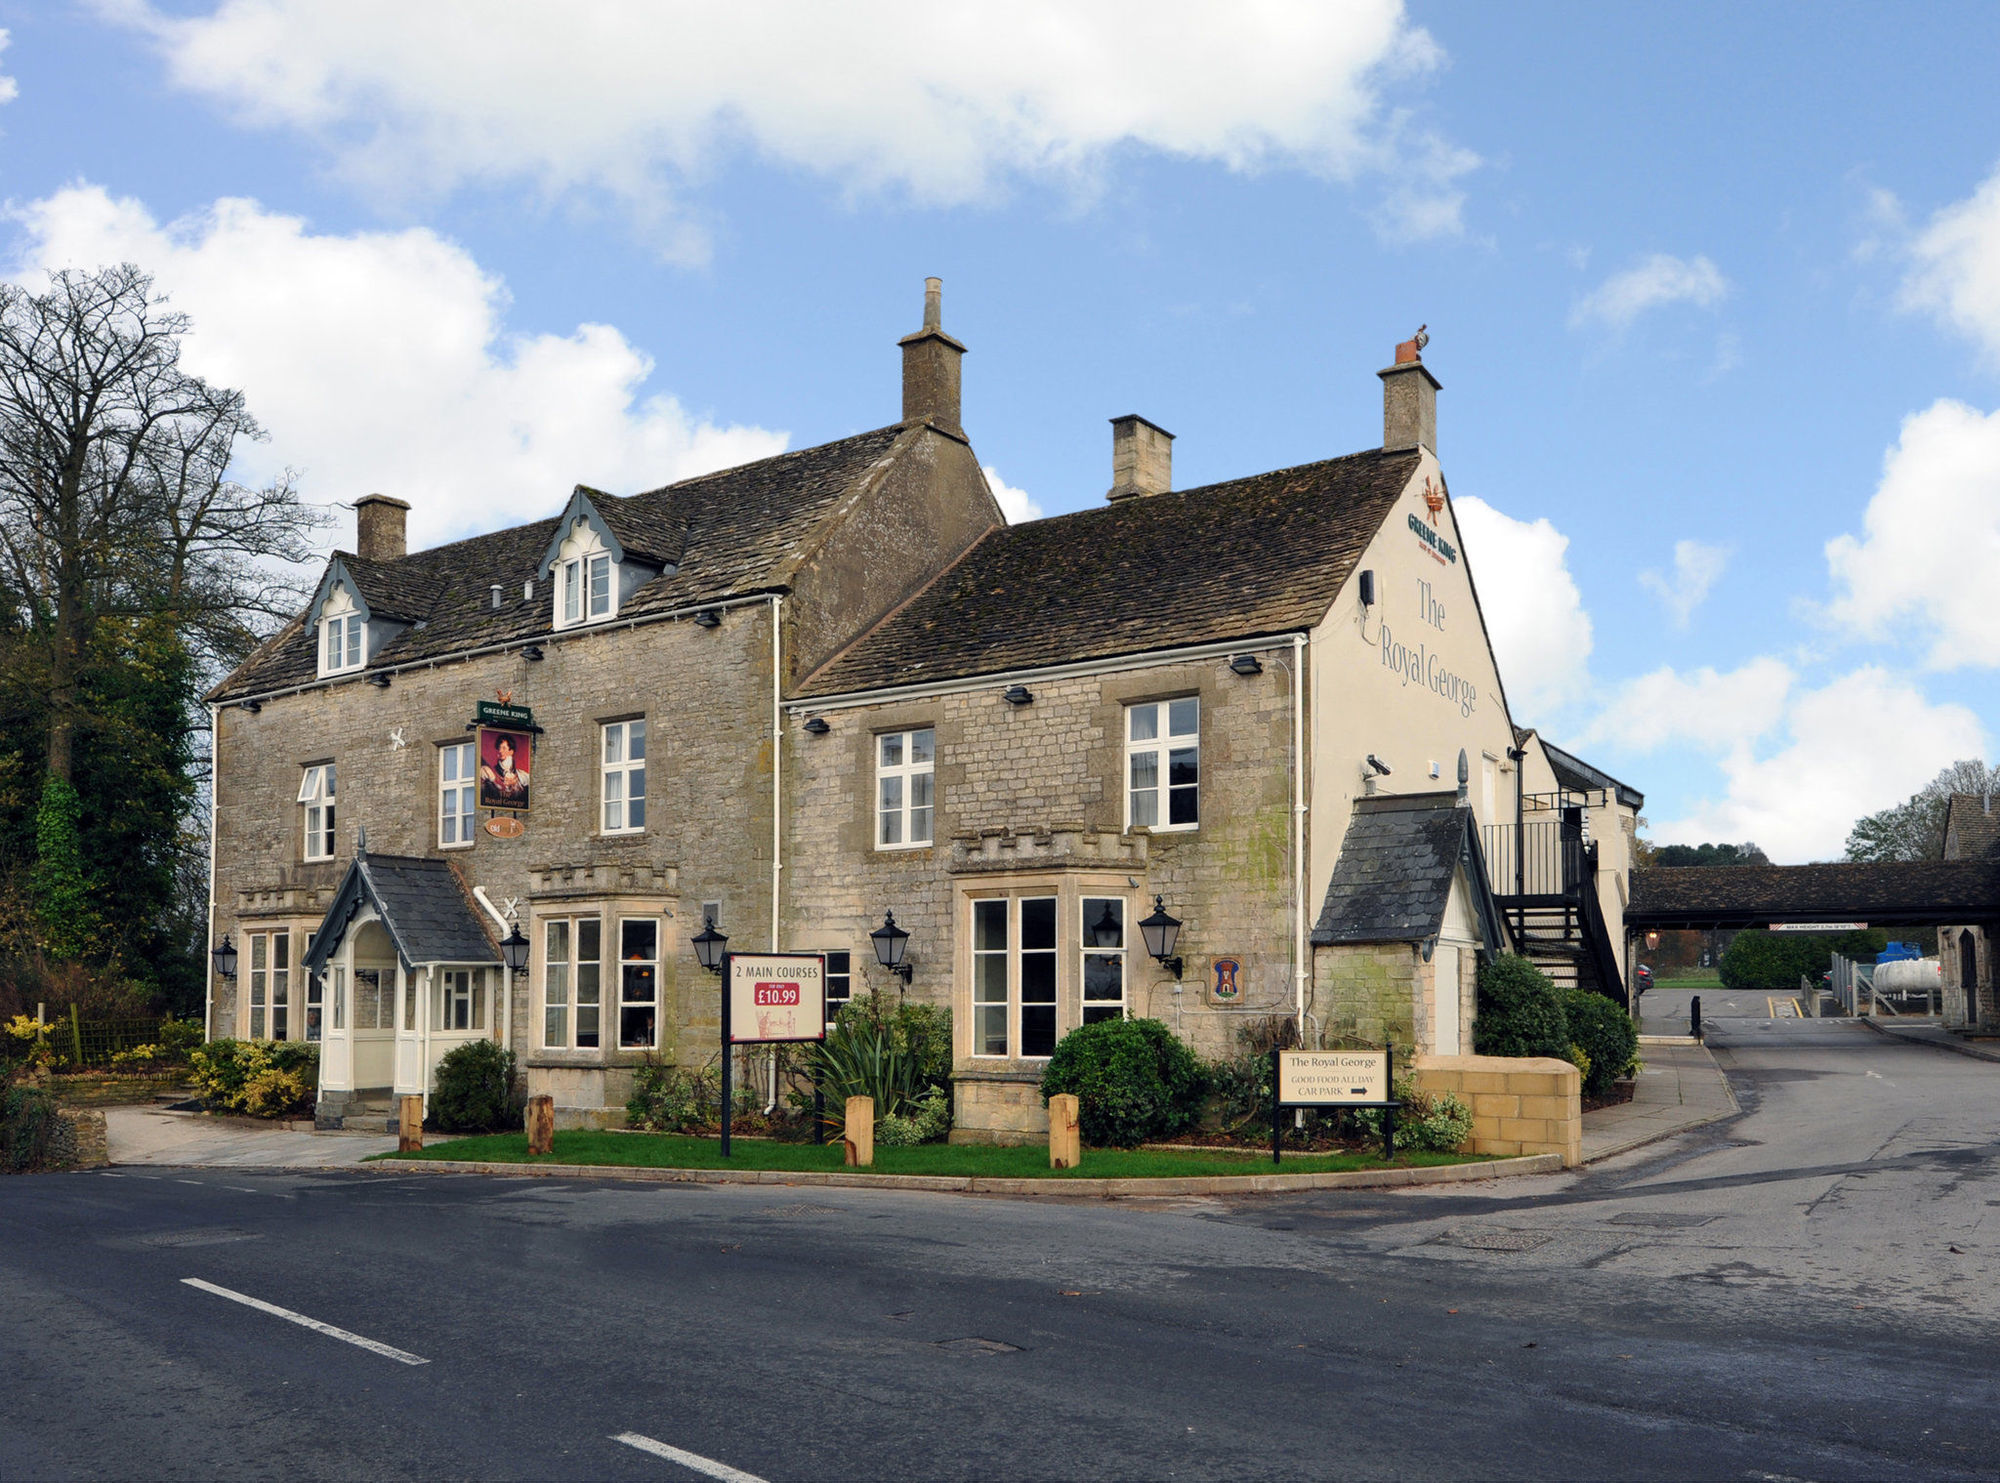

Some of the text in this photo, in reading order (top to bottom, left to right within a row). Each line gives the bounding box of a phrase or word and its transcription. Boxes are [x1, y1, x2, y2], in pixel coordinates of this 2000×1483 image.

[1408, 513, 1437, 548] GREENE
[1438, 536, 1456, 564] KING
[1417, 578, 1445, 632] The
[1382, 625, 1476, 718] Royal George
[482, 707, 510, 716] GREENE
[511, 711, 528, 719] KING
[499, 790, 511, 799] The
[485, 797, 525, 807] Royal George
[736, 966, 818, 978] 2 MAIN COURSES
[759, 989, 796, 1003] £10.99
[1290, 1057, 1377, 1068] The Royal George
[1298, 1087, 1343, 1095] CAR PARK
